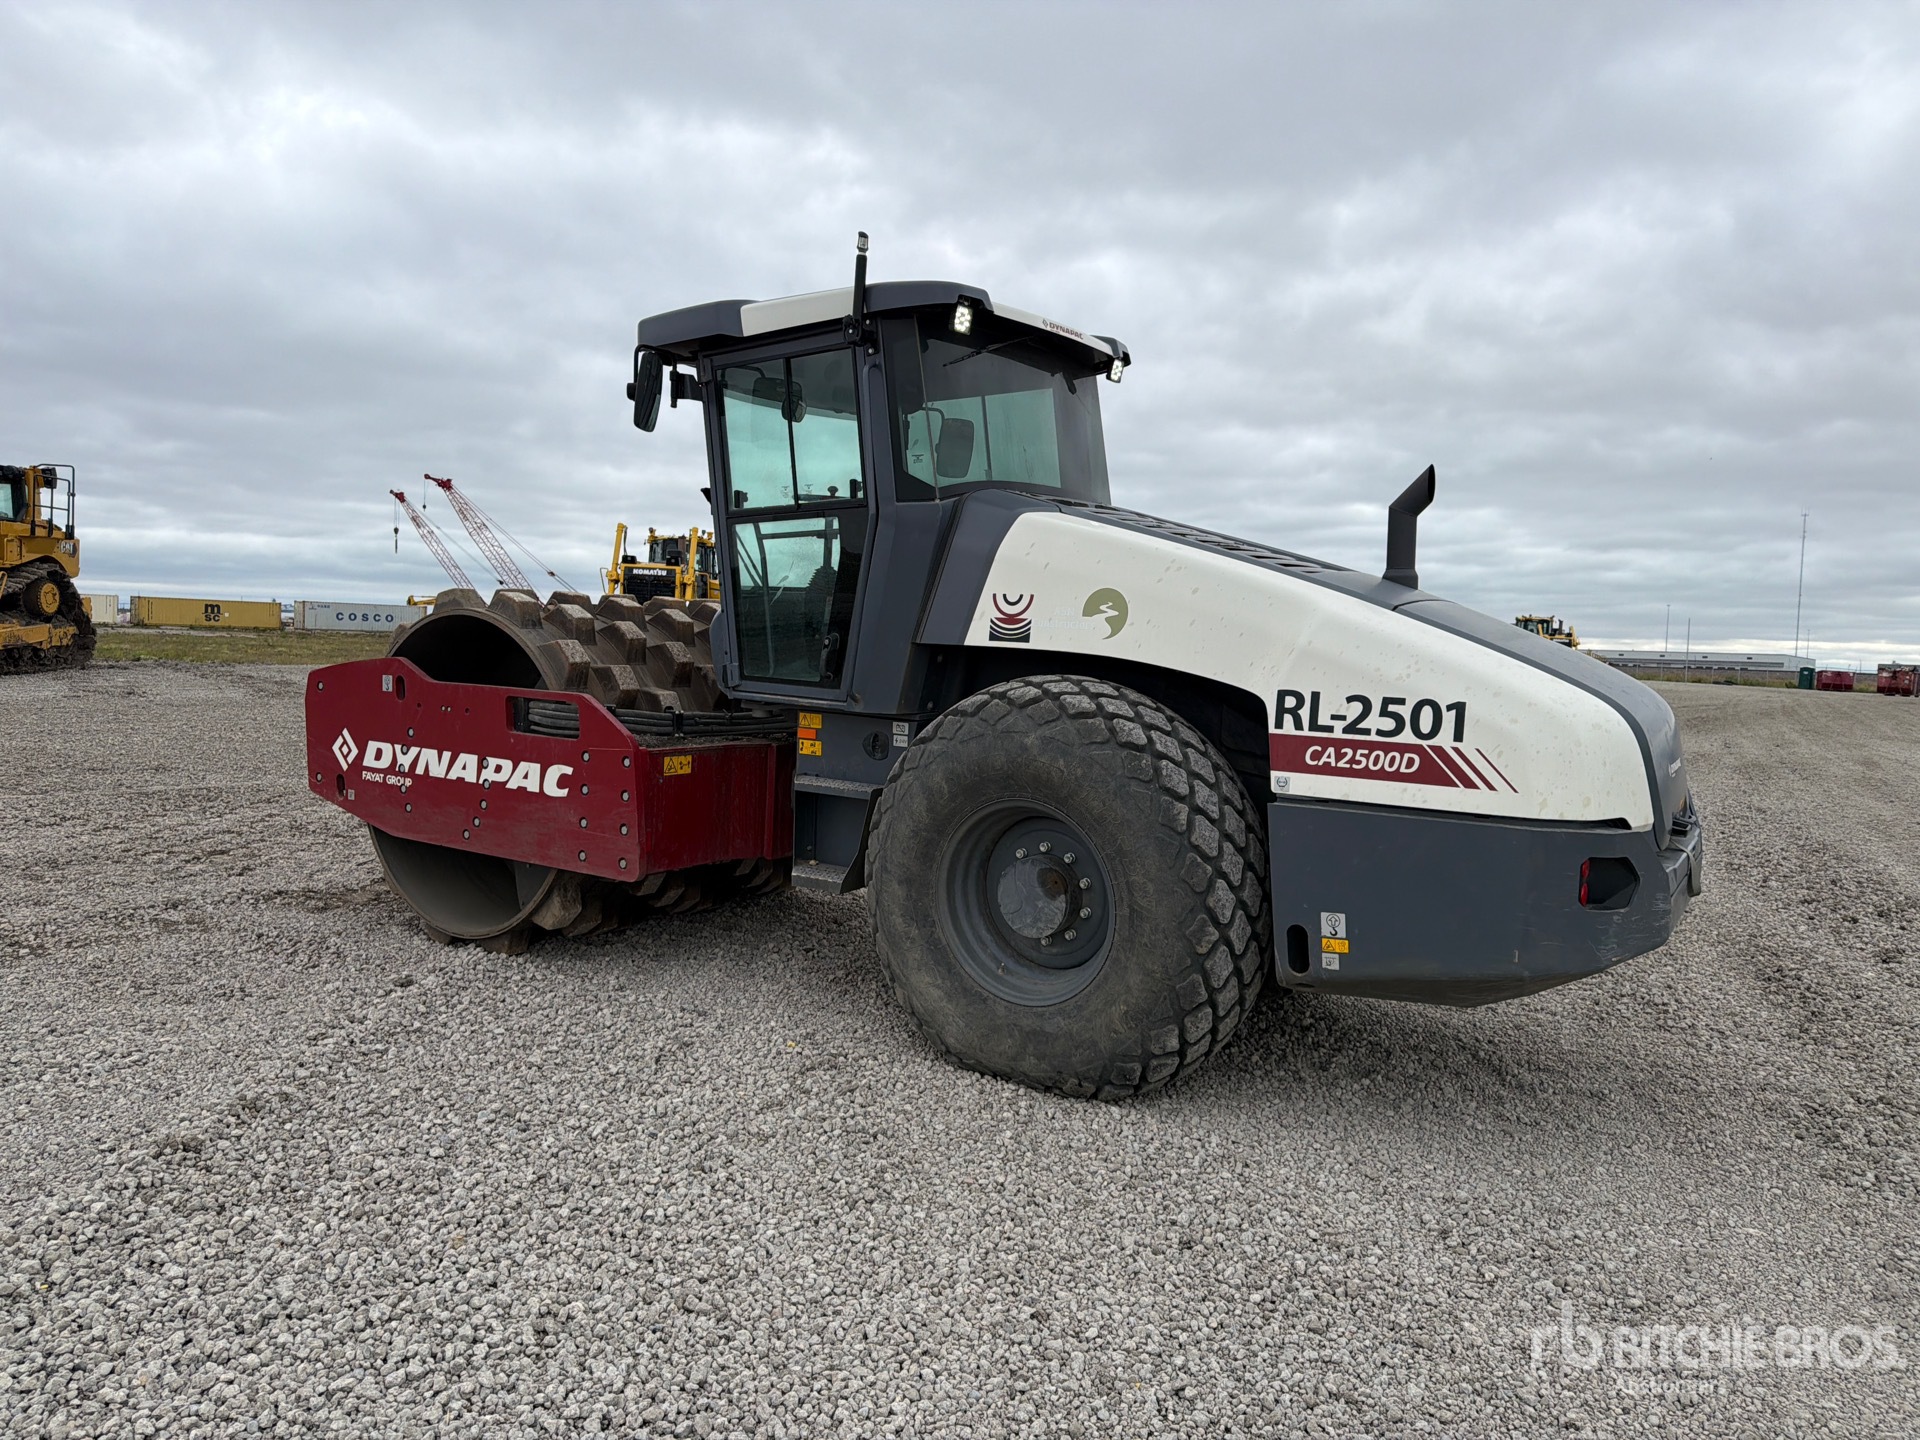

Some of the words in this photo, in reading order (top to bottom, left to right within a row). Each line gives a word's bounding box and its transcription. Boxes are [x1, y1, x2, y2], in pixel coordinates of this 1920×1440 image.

[1049, 322, 1083, 339] DYNAPAC
[60, 541, 74, 554] CAT
[632, 568, 667, 576] KOMATSU
[335, 611, 394, 623] COSCO
[1274, 688, 1467, 743] RL-2501
[1304, 745, 1421, 773] CA2500D
[362, 740, 574, 797] DYNAPAC
[361, 770, 385, 783] FAYAT
[385, 774, 413, 788] GROUP
